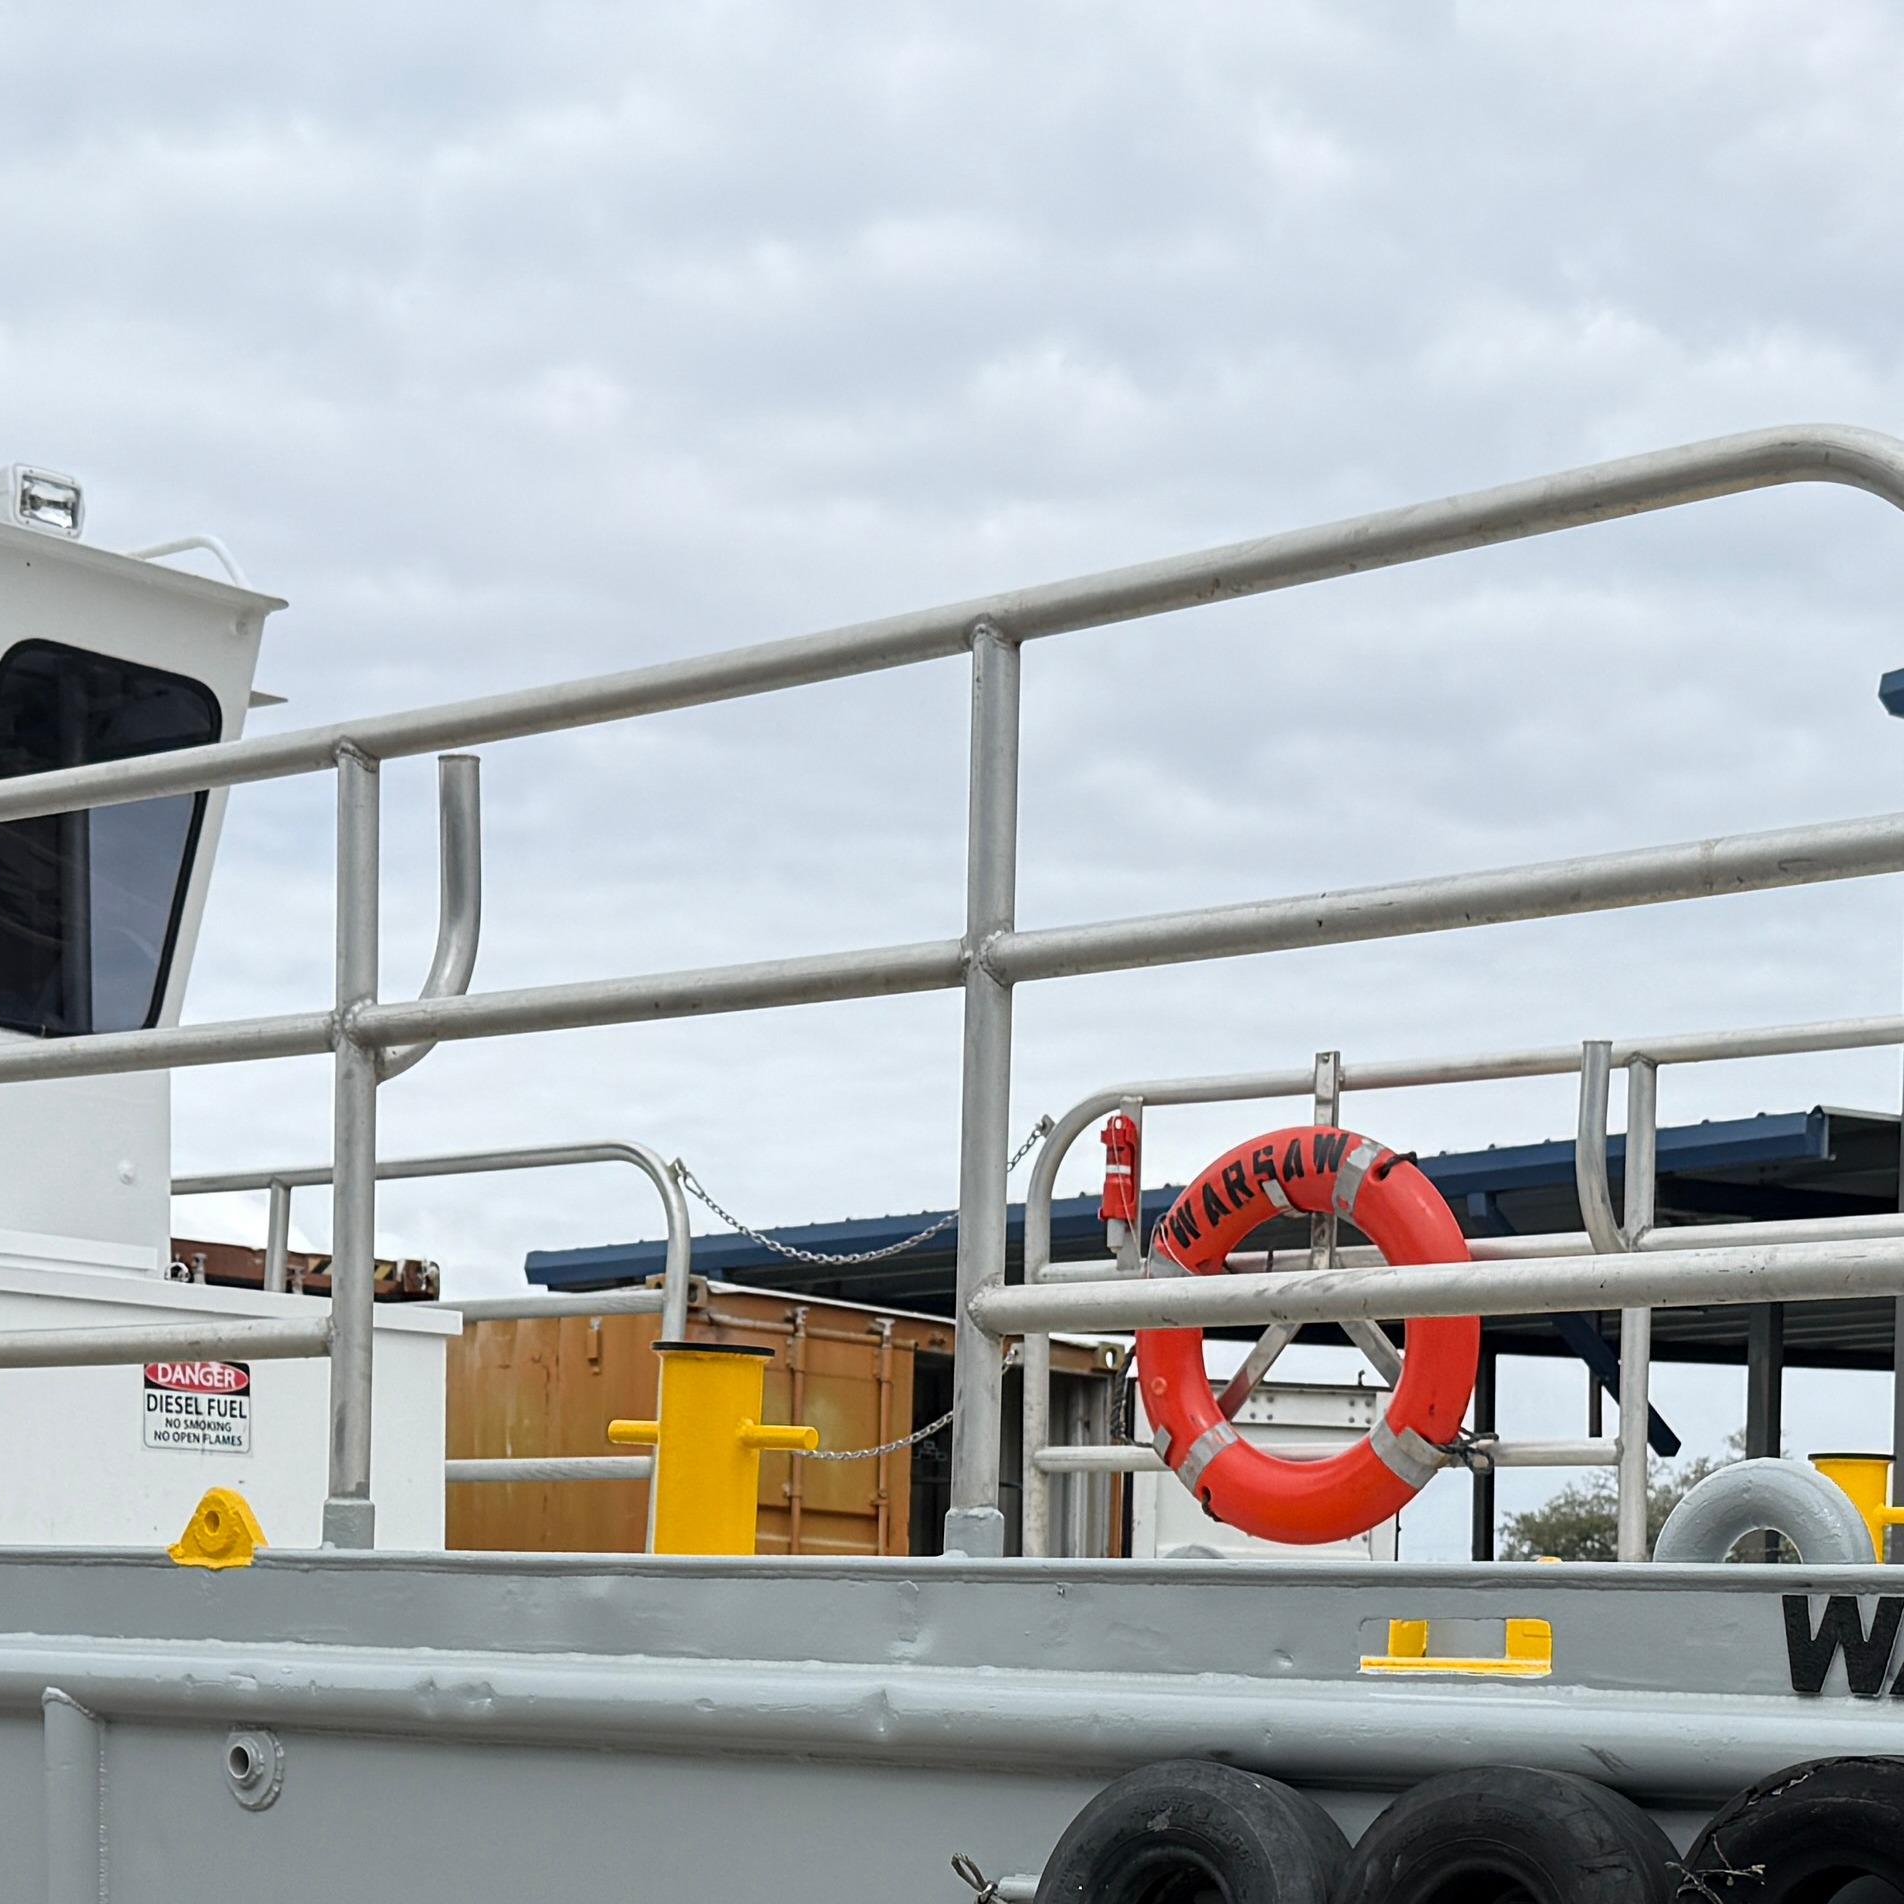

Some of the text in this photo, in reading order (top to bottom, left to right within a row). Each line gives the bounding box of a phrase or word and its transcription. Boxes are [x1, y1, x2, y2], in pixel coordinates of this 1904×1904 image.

[1169, 1133, 1349, 1249] WARSAW
[157, 1361, 236, 1389] DANGER
[147, 1394, 247, 1419] DIESEL FUEL
[165, 1418, 232, 1432] NO SMOKING
[154, 1430, 242, 1446] NO OPEN FLAMES
